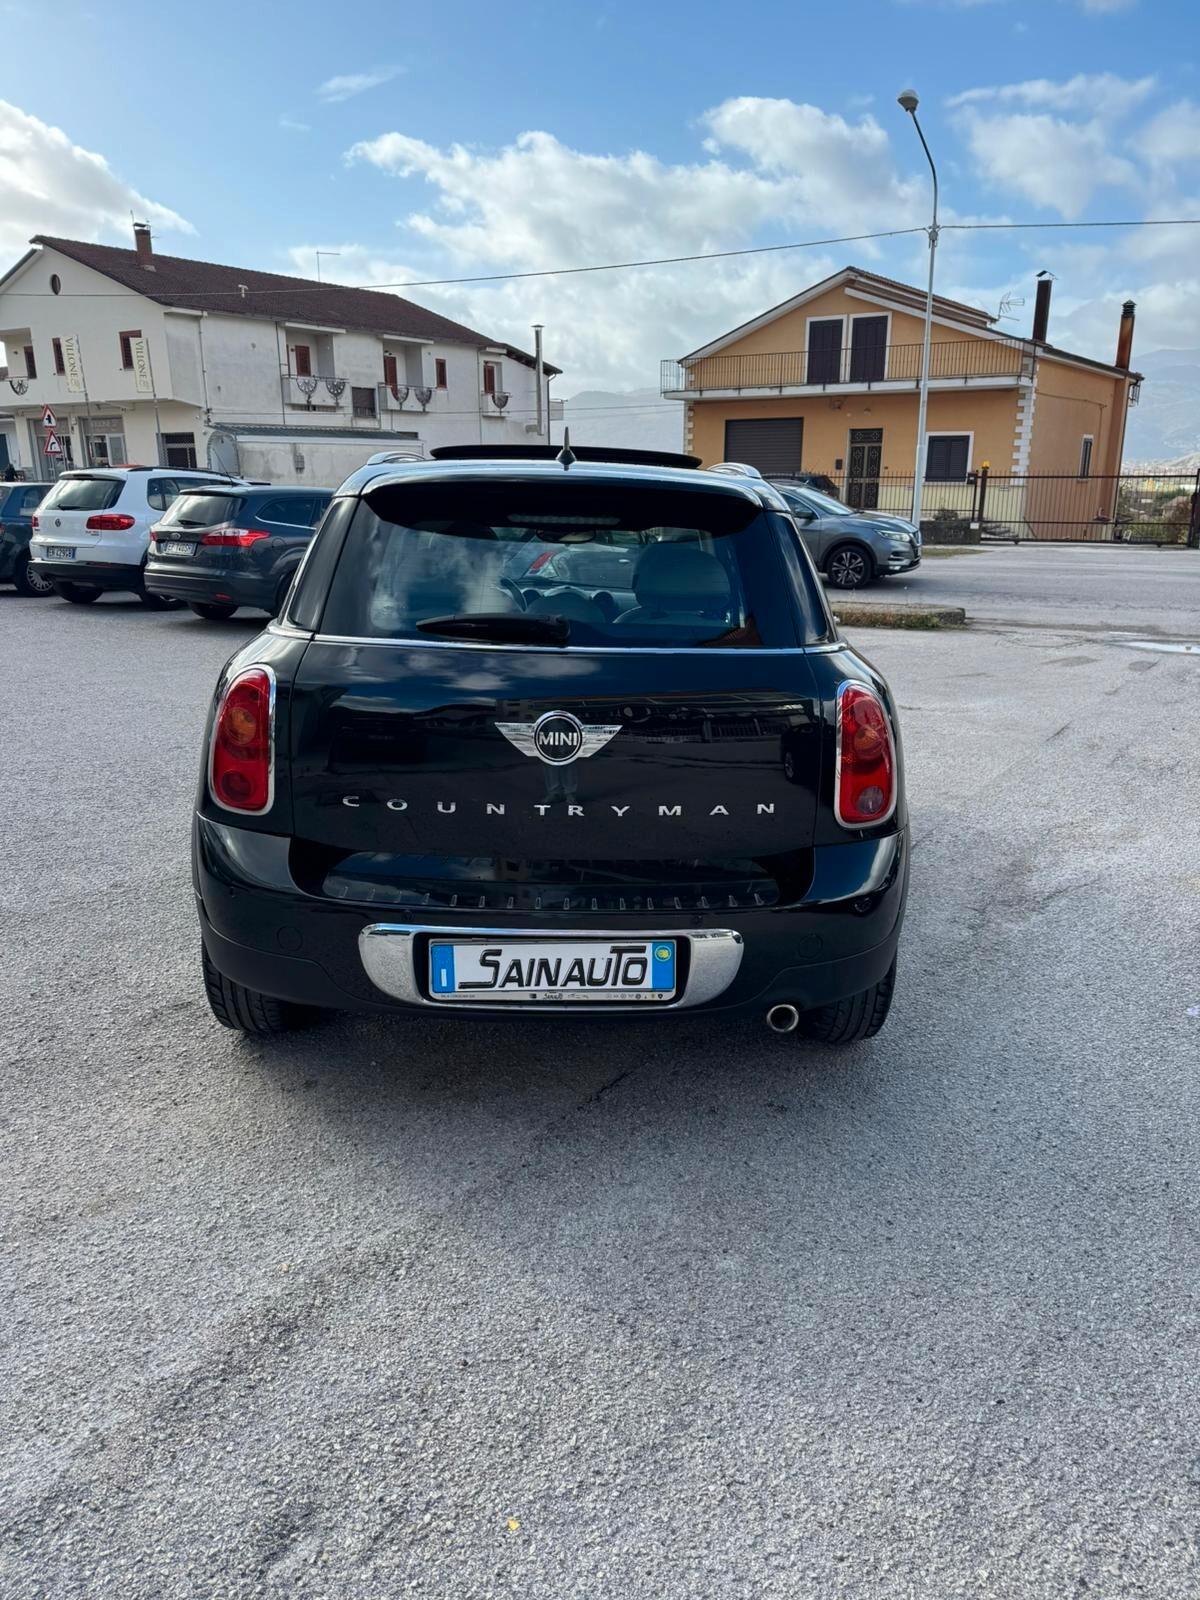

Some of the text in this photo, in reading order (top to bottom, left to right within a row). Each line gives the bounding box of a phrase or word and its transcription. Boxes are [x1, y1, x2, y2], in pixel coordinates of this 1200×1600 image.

[539, 732, 577, 746] MINI
[342, 795, 775, 816] COUNTRYMAN
[458, 945, 648, 989] SAINAUTO
